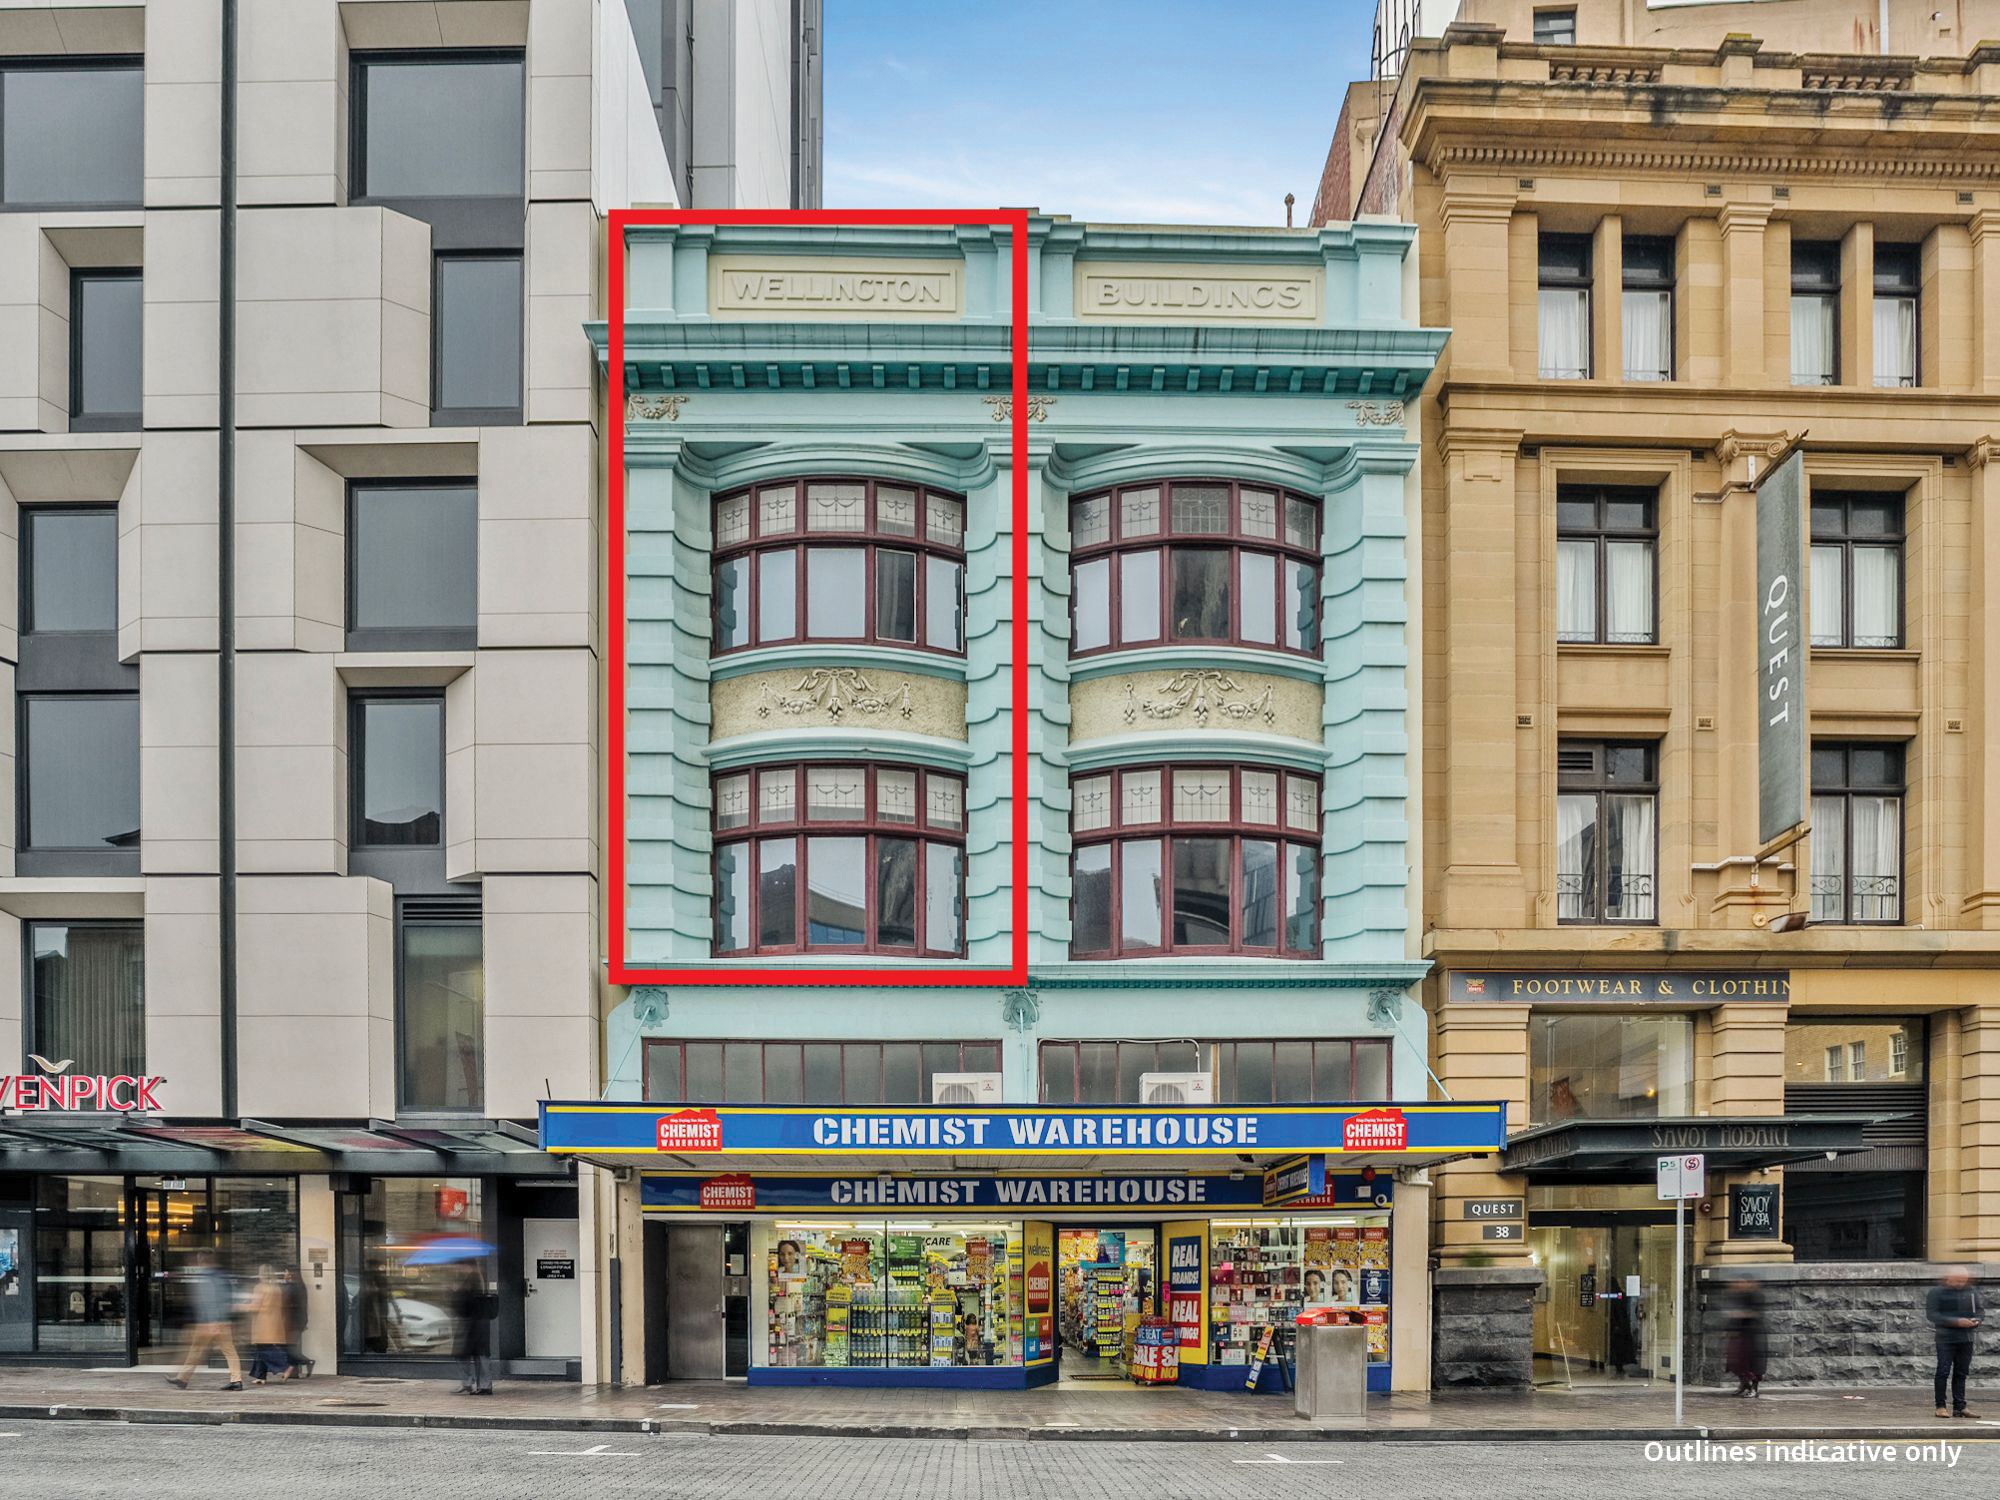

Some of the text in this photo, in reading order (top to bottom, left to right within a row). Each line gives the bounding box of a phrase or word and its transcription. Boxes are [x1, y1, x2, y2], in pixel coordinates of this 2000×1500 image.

[731, 275, 941, 302] WELLINGTON
[1098, 281, 1302, 309] BUILDINGS
[1765, 575, 1788, 727] QUEST
[1512, 979, 1643, 995] FOOTWEAR
[1658, 980, 1674, 995] &
[660, 1123, 720, 1138] CHEMIST
[813, 1117, 1258, 1145] CHEMIST WAREHOUSE
[1346, 1123, 1405, 1138] CHEMIST
[1652, 1126, 1791, 1148] SAVOY HOBART
[661, 1139, 718, 1147] WAREHOUSE
[1346, 1139, 1402, 1147] WAREHOUSE
[703, 1186, 753, 1198] CHEMIST
[831, 1180, 1206, 1203] CHEMIST WAREHOUSE
[1471, 1204, 1515, 1216] QUEST
[1740, 1196, 1770, 1212] SAVOY
[1740, 1213, 1770, 1226] DAY SPA
[1495, 1226, 1510, 1238] 38
[1172, 1244, 1199, 1267] REAL
[1028, 1276, 1049, 1291] CHEMIST
[1172, 1271, 1199, 1284] BRANDS!
[1172, 1300, 1199, 1323] REAL
